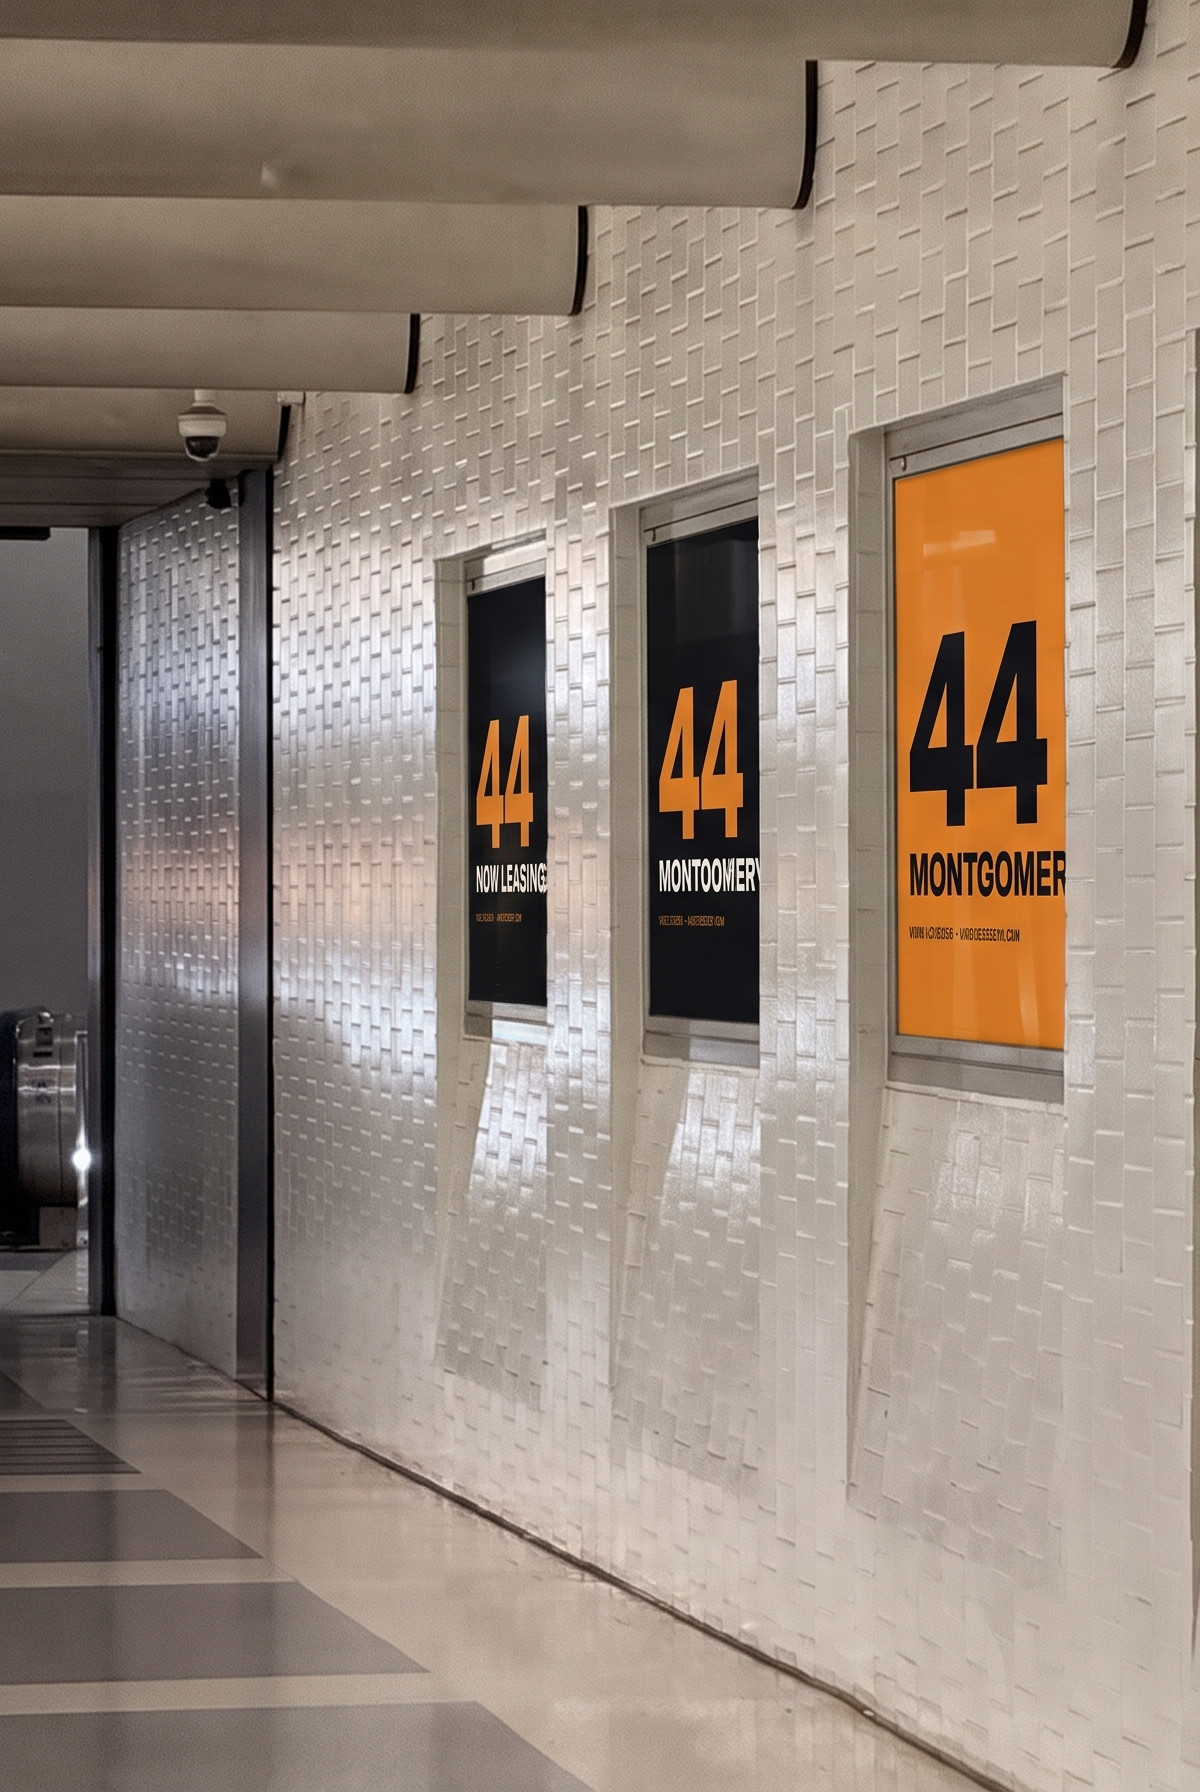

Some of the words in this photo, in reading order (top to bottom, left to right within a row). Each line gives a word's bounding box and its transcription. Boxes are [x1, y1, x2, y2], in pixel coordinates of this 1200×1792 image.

[476, 714, 534, 849] 44
[658, 679, 744, 840] 44
[908, 620, 1048, 827] 44
[476, 864, 499, 893] NOW
[909, 850, 1066, 897] MONTGOMER
